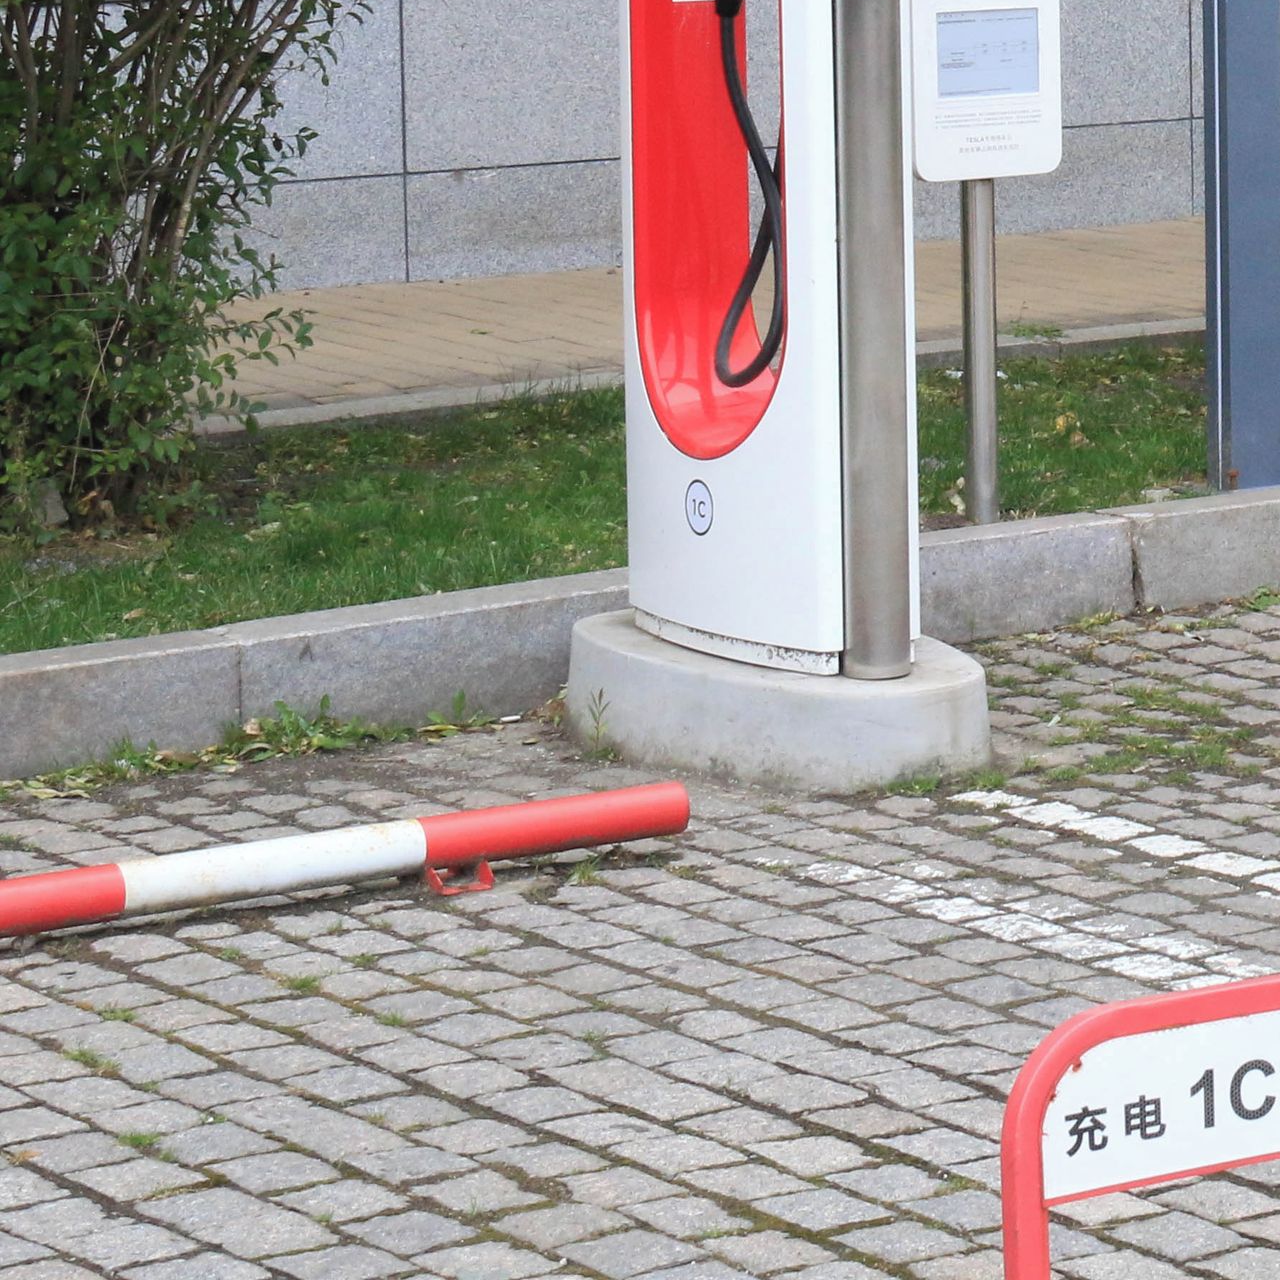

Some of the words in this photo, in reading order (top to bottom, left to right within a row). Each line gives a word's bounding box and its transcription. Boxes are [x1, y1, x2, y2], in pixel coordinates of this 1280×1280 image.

[691, 498, 707, 519] 1C
[1064, 1094, 1167, 1158] 充电
[1189, 1058, 1277, 1129] 1C
